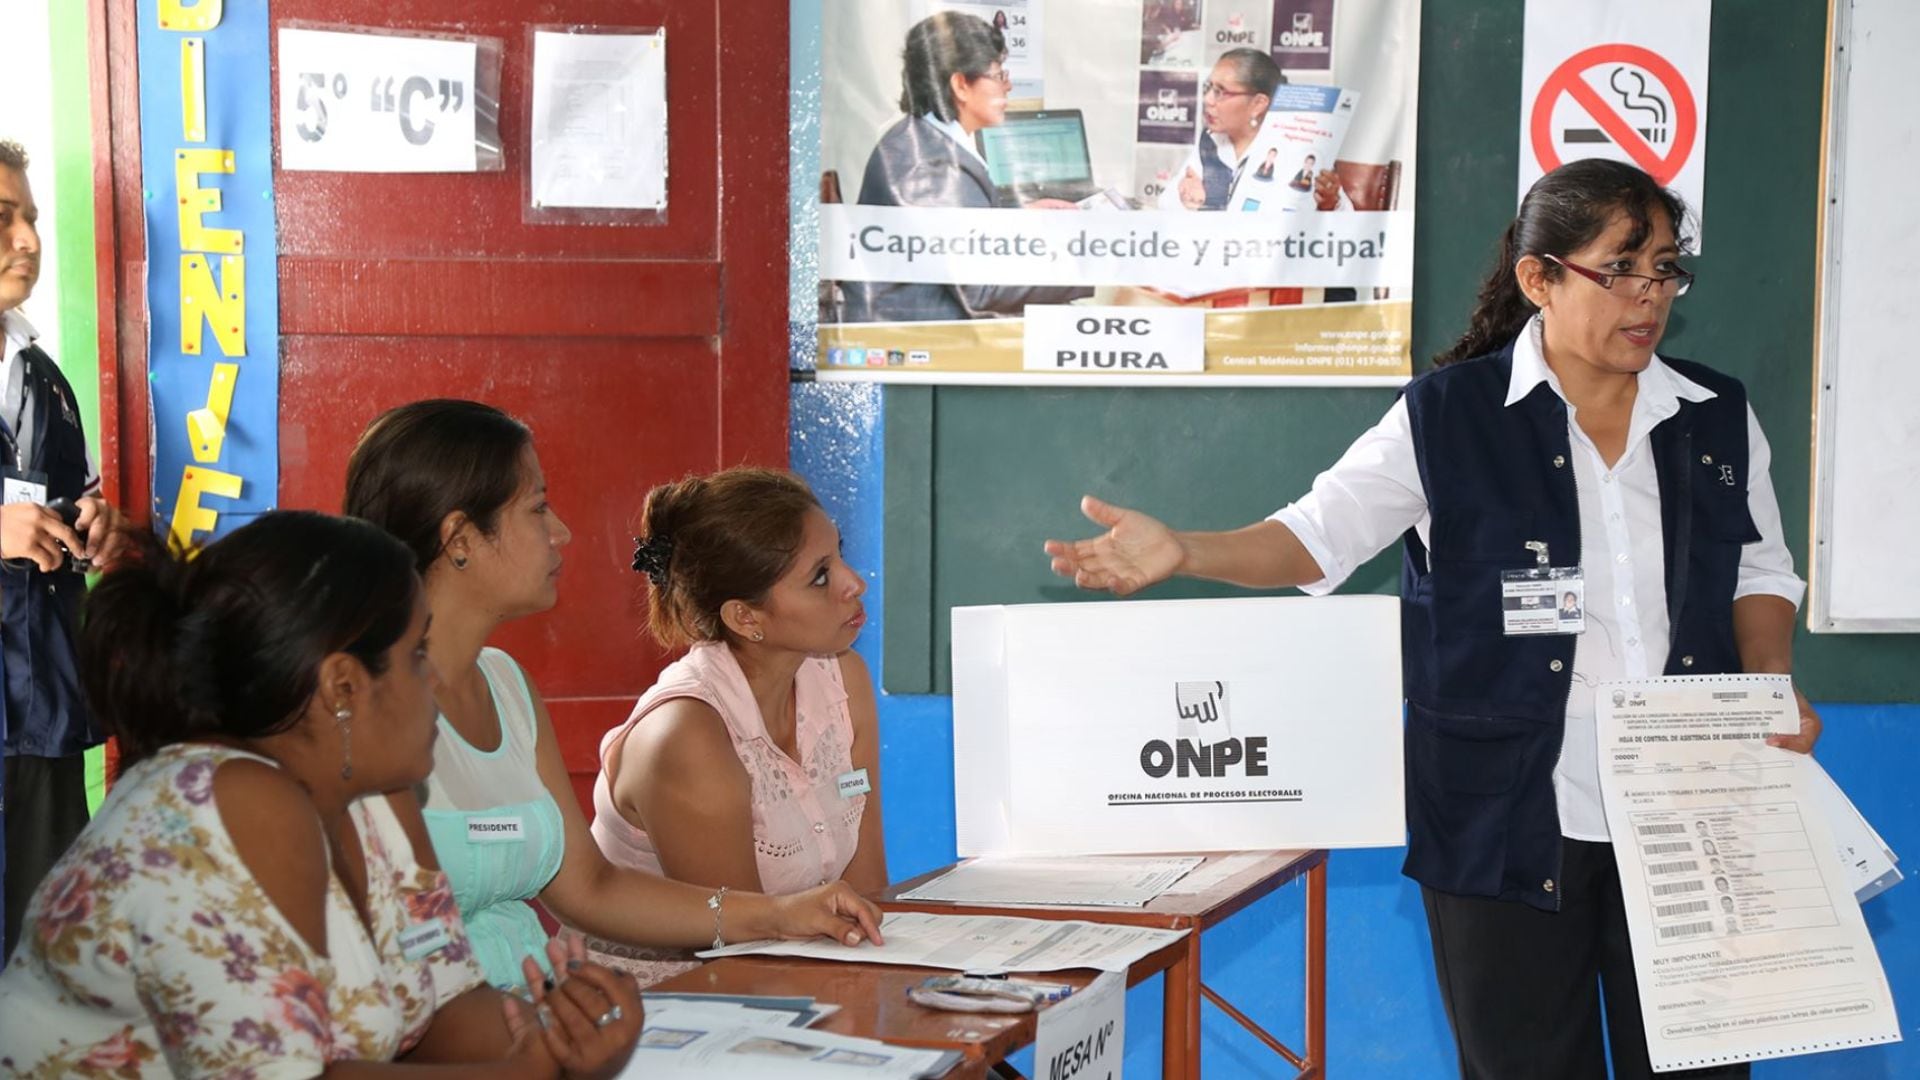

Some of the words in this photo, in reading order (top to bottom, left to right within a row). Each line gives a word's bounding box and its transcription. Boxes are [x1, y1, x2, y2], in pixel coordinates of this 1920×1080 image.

[1011, 15, 1026, 26] 34
[1011, 37, 1026, 48] 36
[1216, 30, 1255, 43] ONPE
[1280, 31, 1324, 47] ONPE
[1146, 106, 1188, 121] ONPE
[849, 225, 1058, 262] ¡Capacítate,
[1067, 230, 1180, 257] decide
[1193, 238, 1210, 266] y
[1223, 231, 1386, 267] participa!
[1076, 317, 1152, 336] ORC
[1056, 350, 1169, 369] PIURA
[1223, 356, 1256, 366] Central
[1306, 356, 1332, 366] ONPE
[1140, 736, 1268, 778] ONPE
[1108, 792, 1142, 801] OFICINA
[1144, 791, 1187, 800] NACIONAL
[1190, 791, 1201, 799] DE
[1203, 790, 1246, 798] PROCESOS
[1248, 789, 1303, 797] ELECTORALES
[468, 823, 518, 832] PRESIDENTE
[1049, 1034, 1092, 1080] MESA
